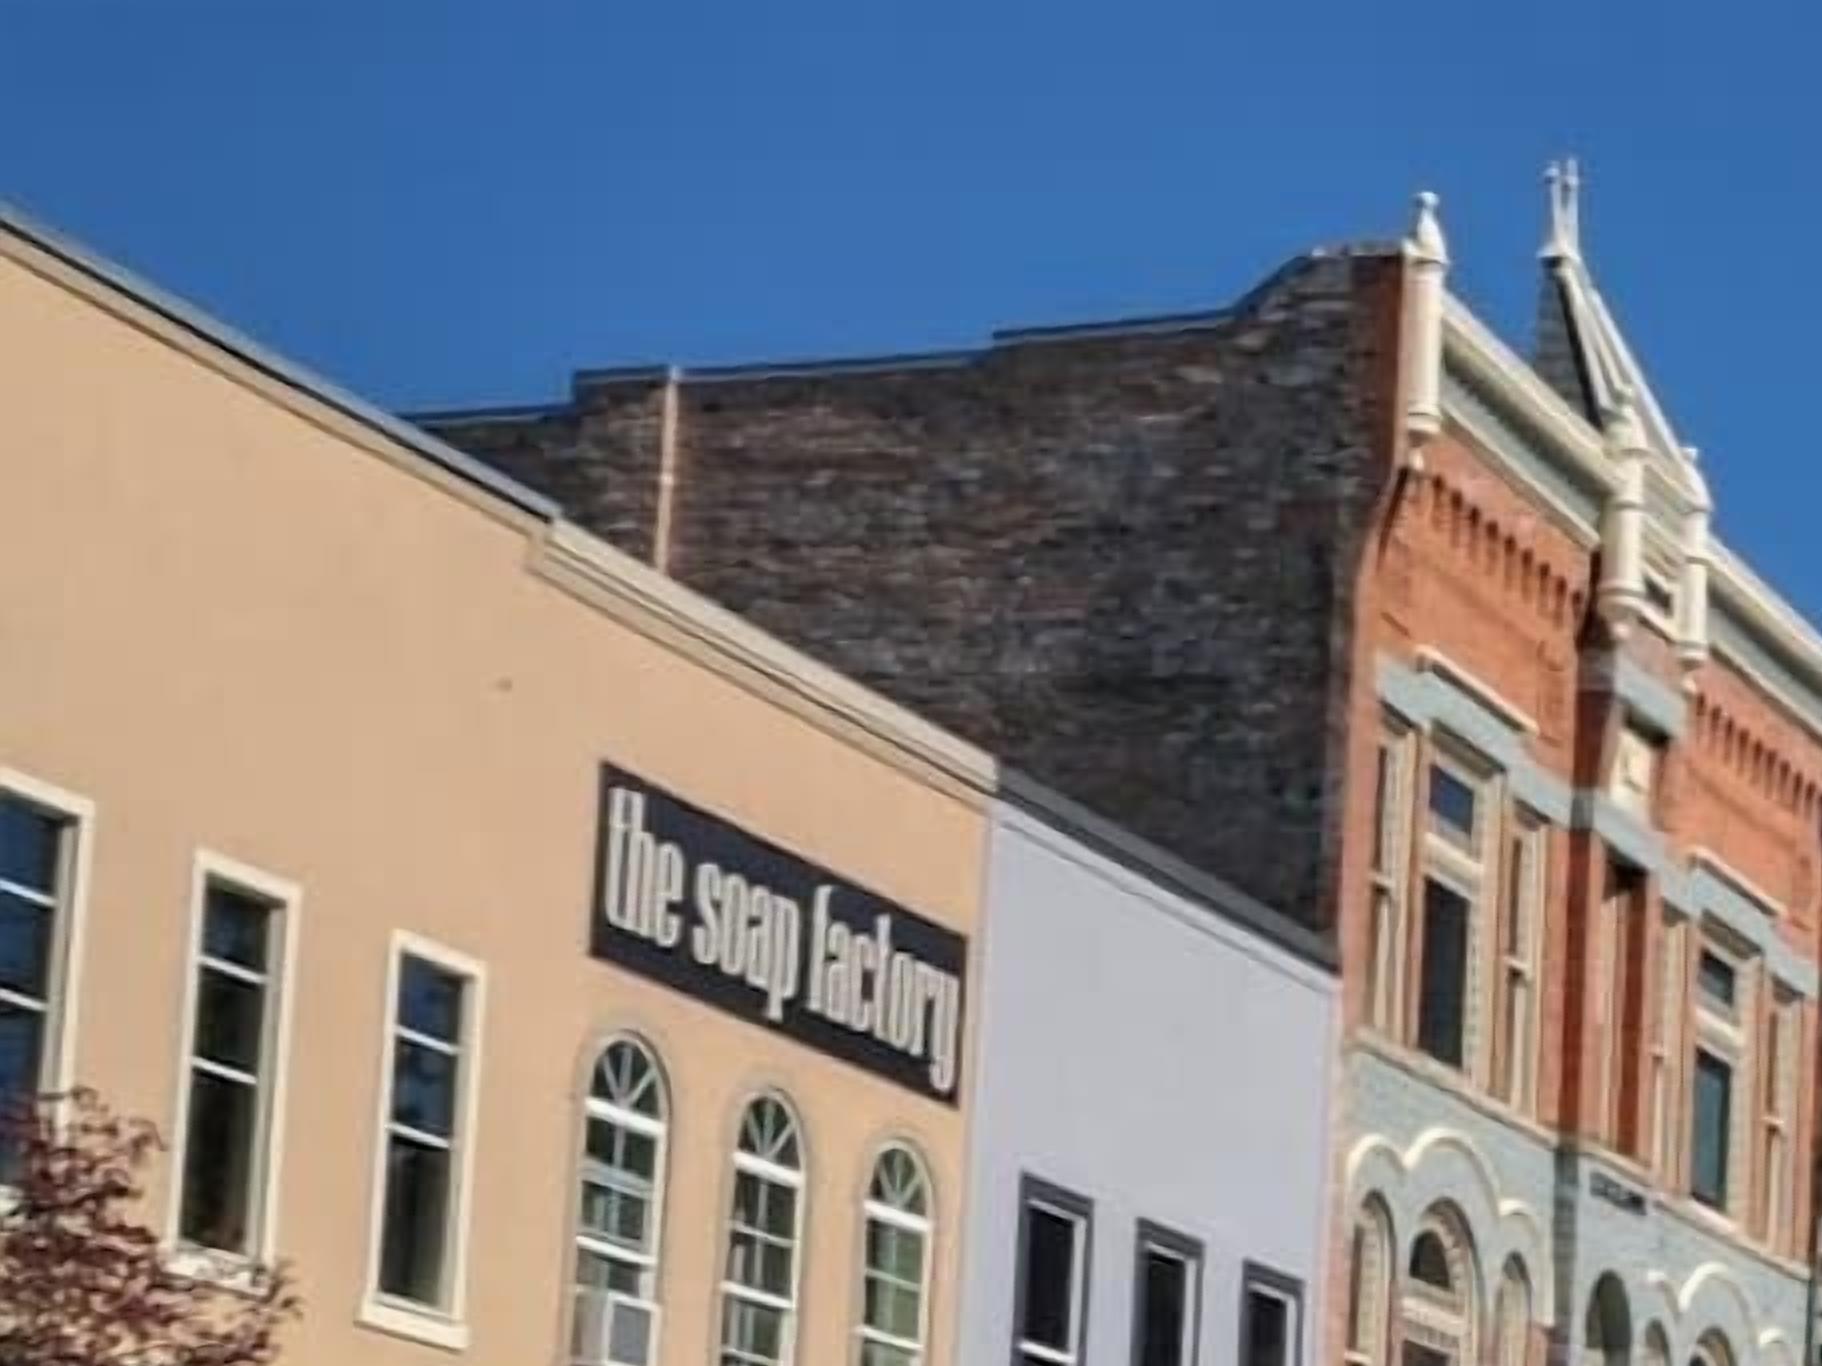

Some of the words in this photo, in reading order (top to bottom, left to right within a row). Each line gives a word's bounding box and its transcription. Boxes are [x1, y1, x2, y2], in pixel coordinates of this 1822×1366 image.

[605, 786, 684, 948] the
[692, 861, 800, 1021] soap
[807, 884, 961, 1092] factory
